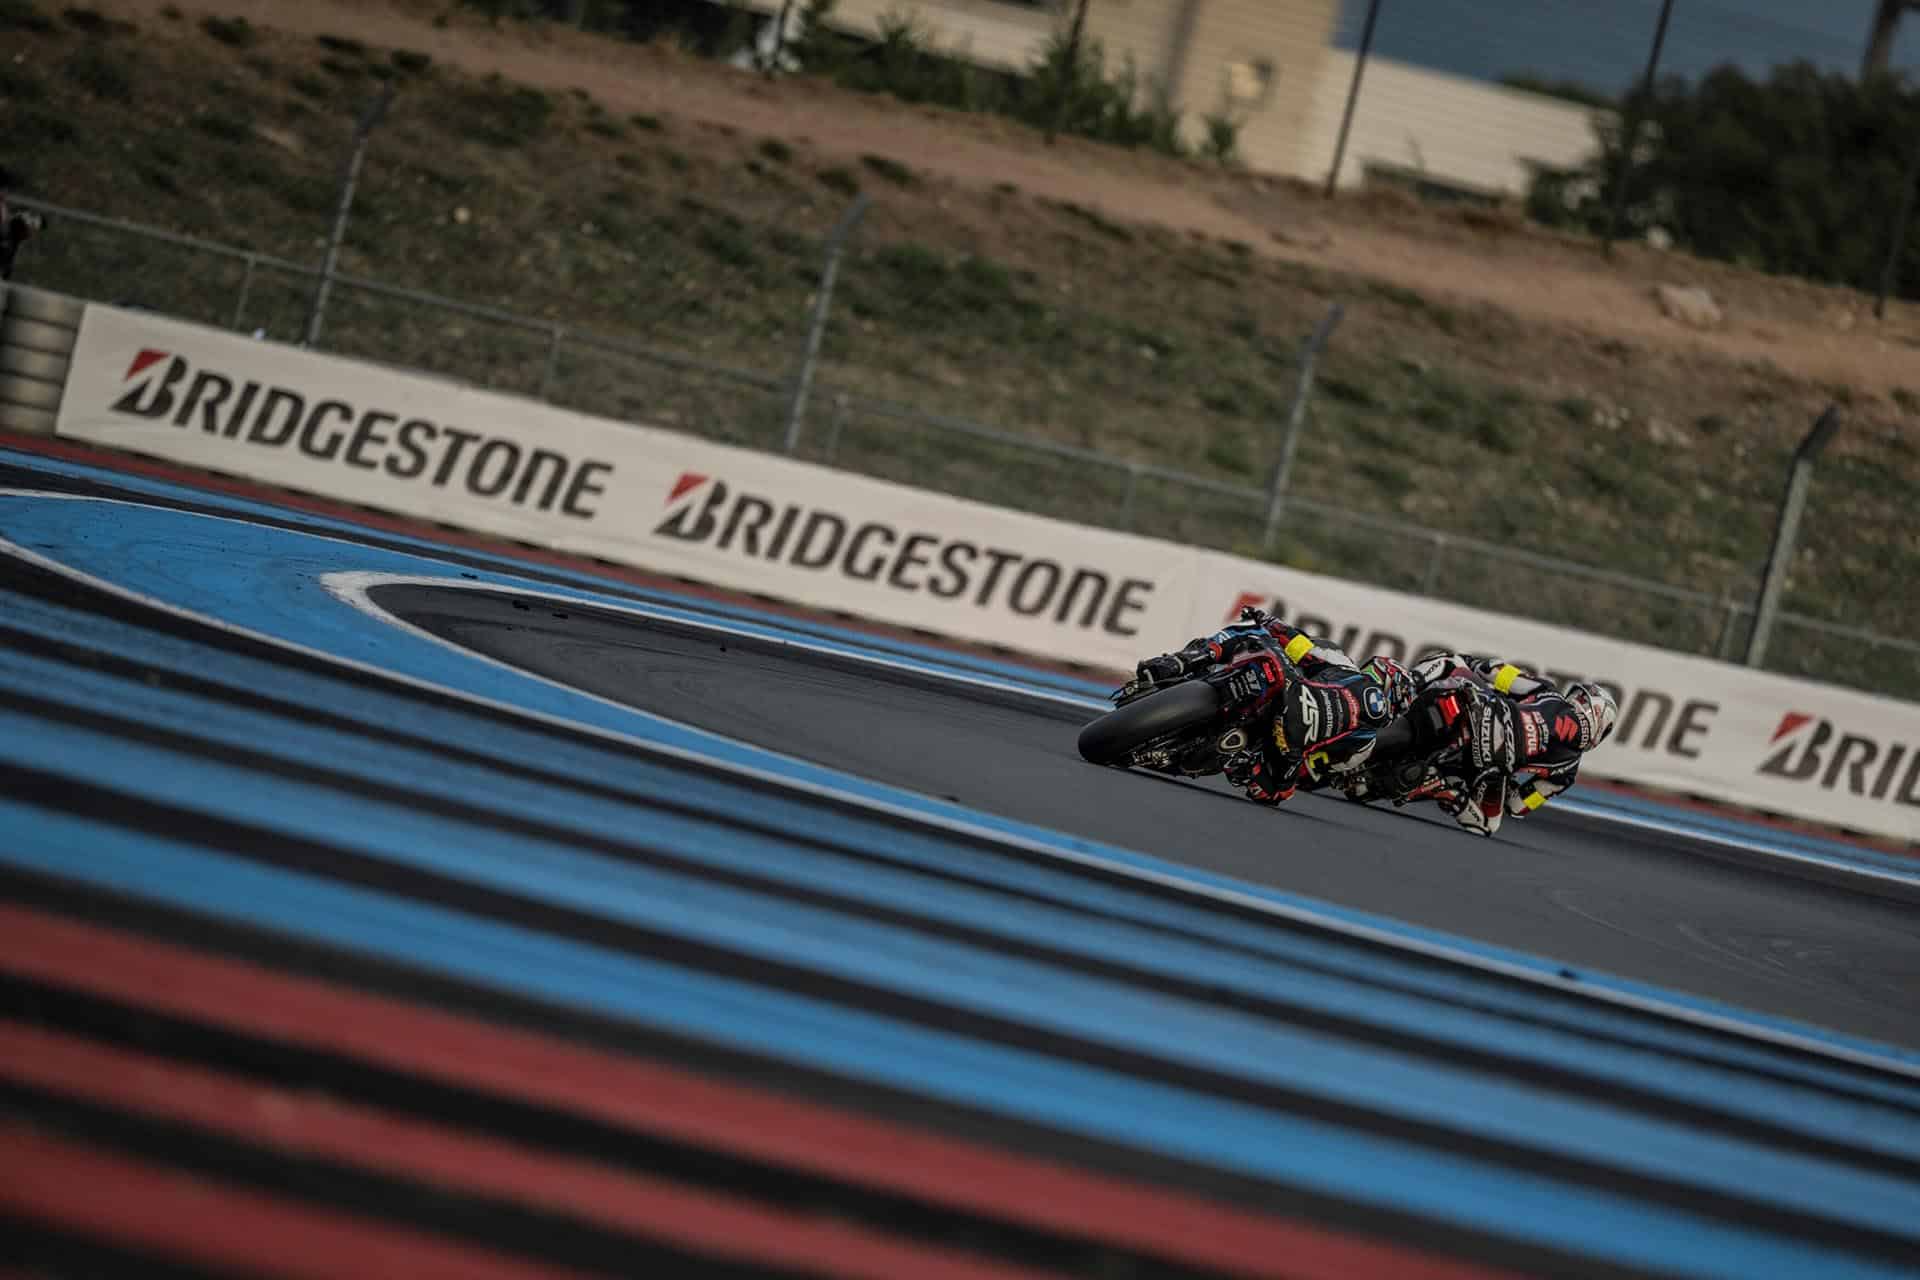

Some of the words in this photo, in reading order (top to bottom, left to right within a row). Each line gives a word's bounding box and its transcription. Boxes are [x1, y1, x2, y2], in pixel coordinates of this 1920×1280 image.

[111, 348, 614, 520] BRIDGESTONE
[653, 473, 1156, 638] BRIDGESTONE
[1480, 706, 1492, 763] SUZUKI
[1522, 712, 1538, 753] MOTUL
